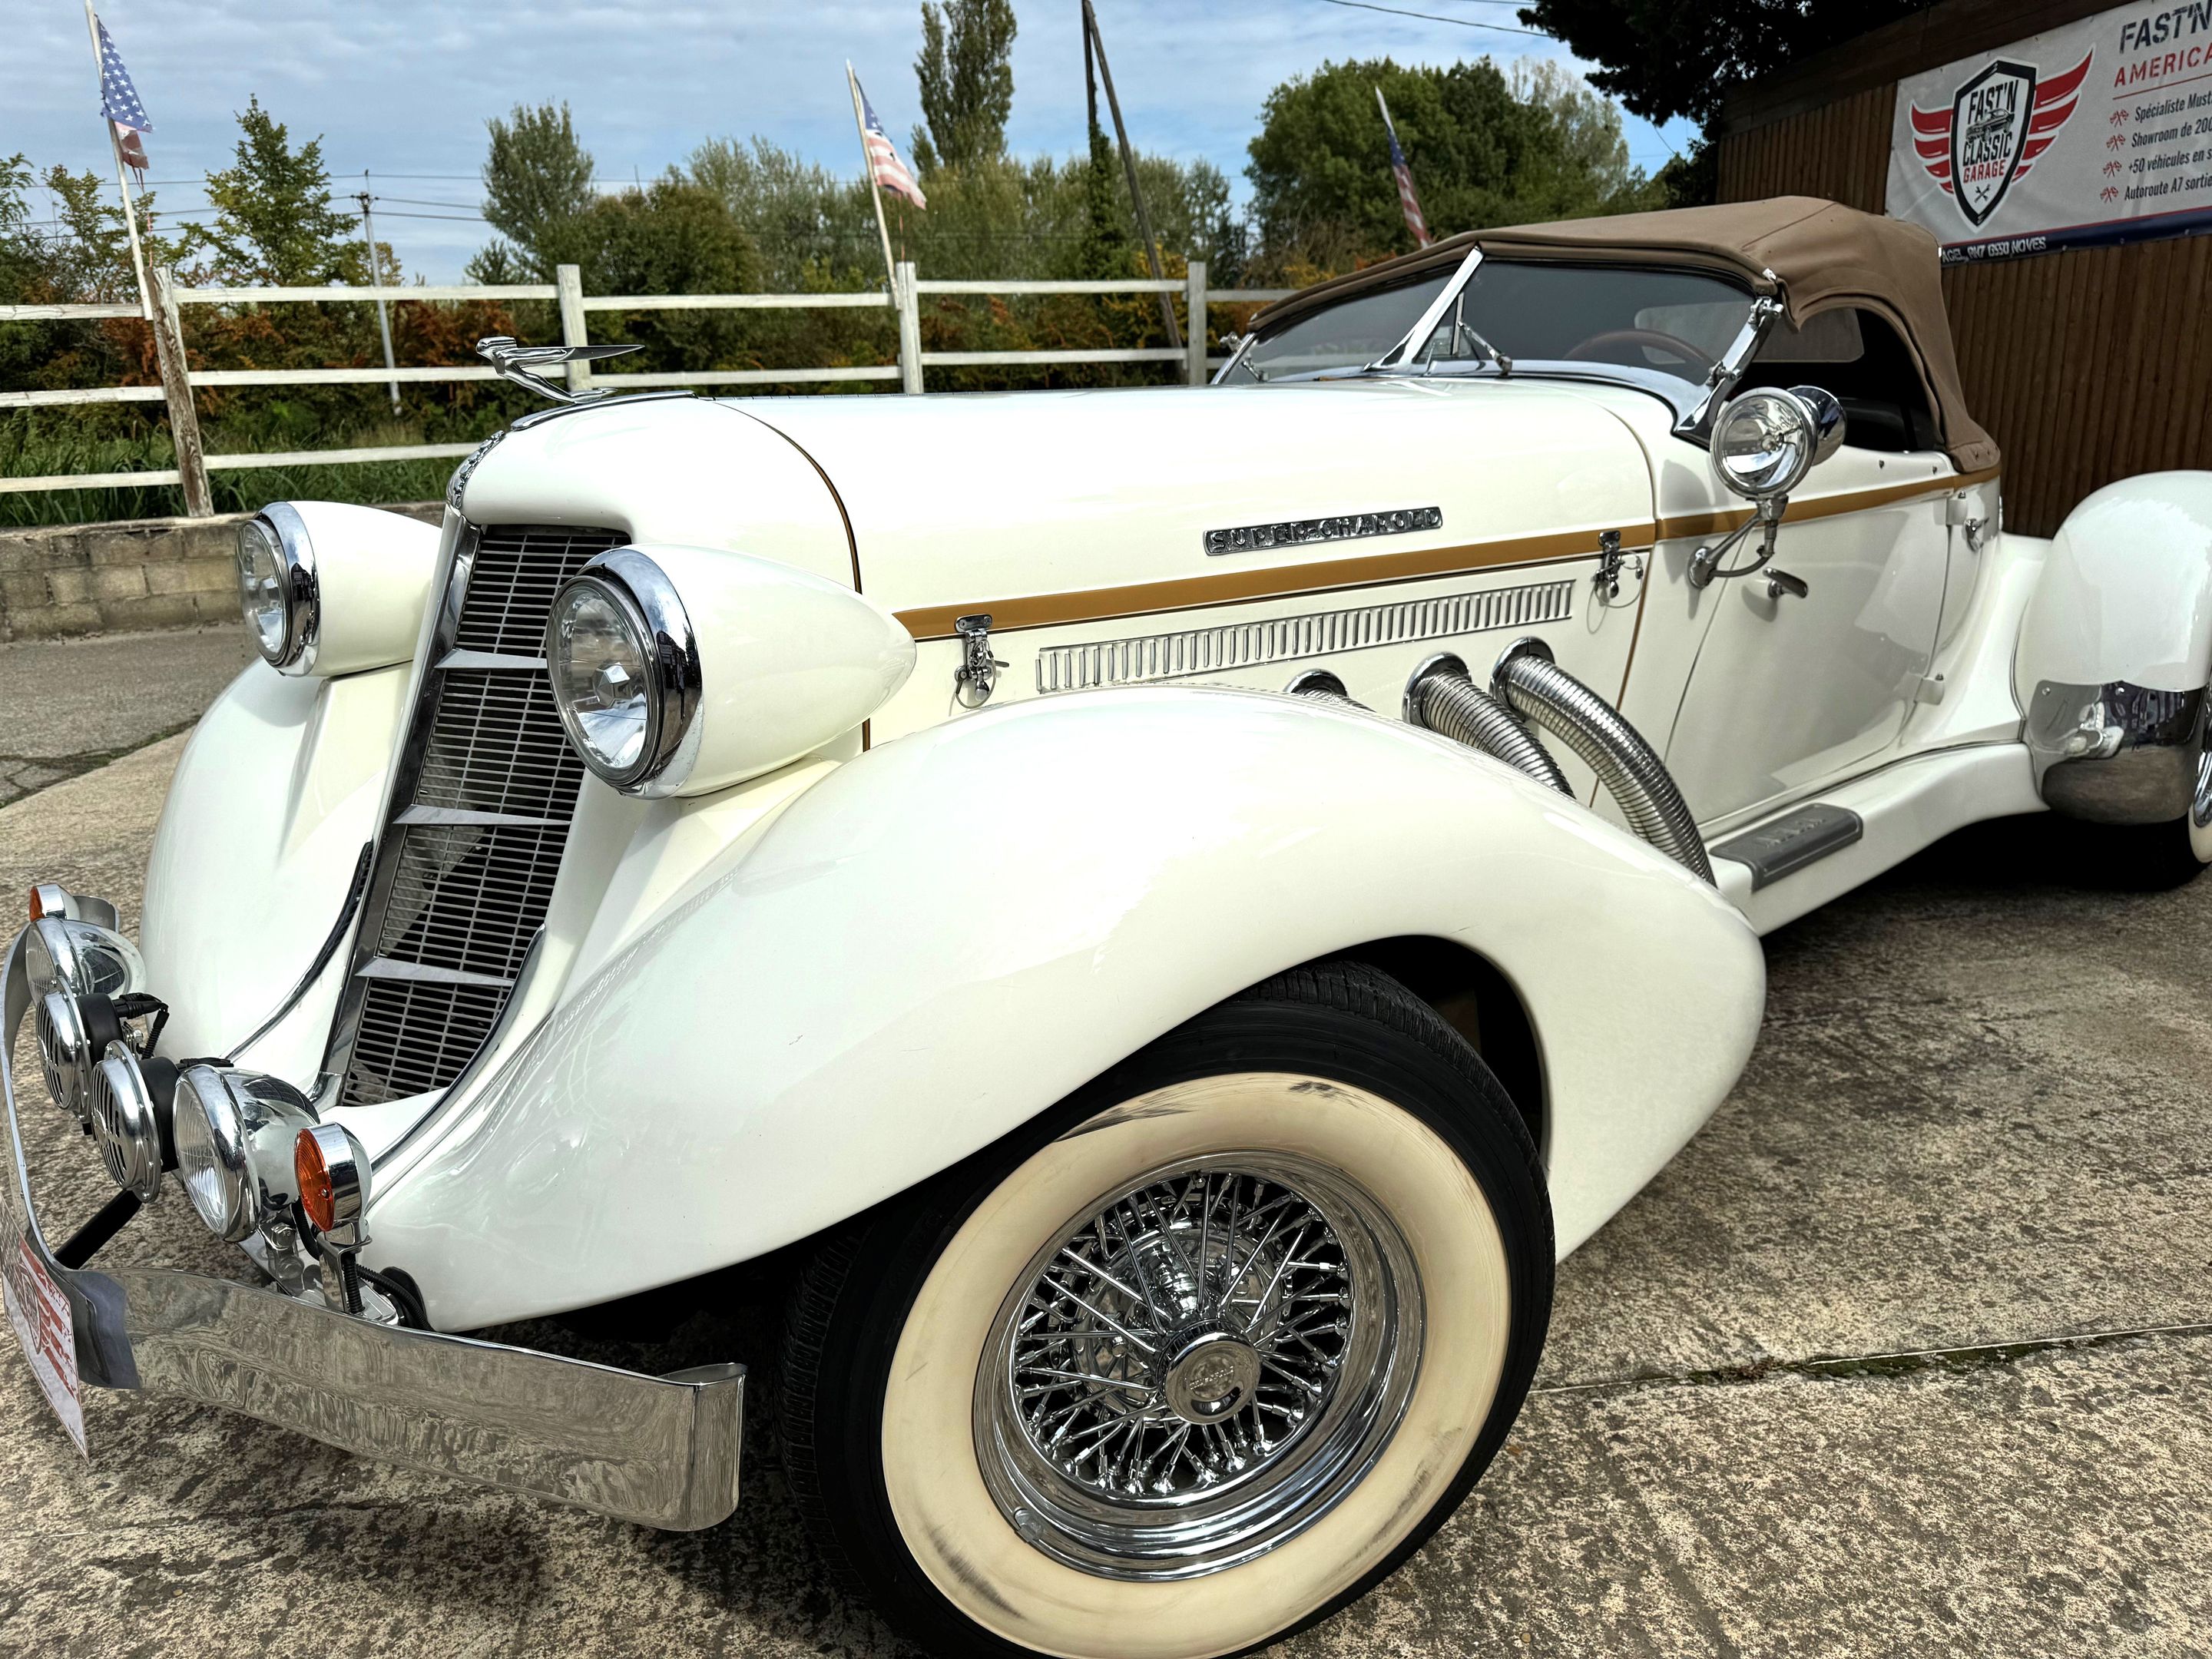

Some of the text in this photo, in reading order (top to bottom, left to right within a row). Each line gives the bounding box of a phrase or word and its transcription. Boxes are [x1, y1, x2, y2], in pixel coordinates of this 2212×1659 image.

[2120, 0, 2212, 54] FAST'N
[1968, 79, 2018, 124] FAST'N
[2134, 90, 2212, 124] Spécialiste Must
[2131, 127, 2178, 148] Showroom
[2180, 122, 2193, 137] de
[1962, 131, 2012, 167] CLASSIC
[2128, 157, 2145, 174] +50
[2147, 151, 2190, 171] véhicules
[2192, 150, 2205, 163] en
[1963, 159, 2006, 184] GARAGE
[2124, 180, 2169, 200] Autoroute
[2171, 176, 2184, 193] A7
[2012, 236, 2047, 254] NOVES
